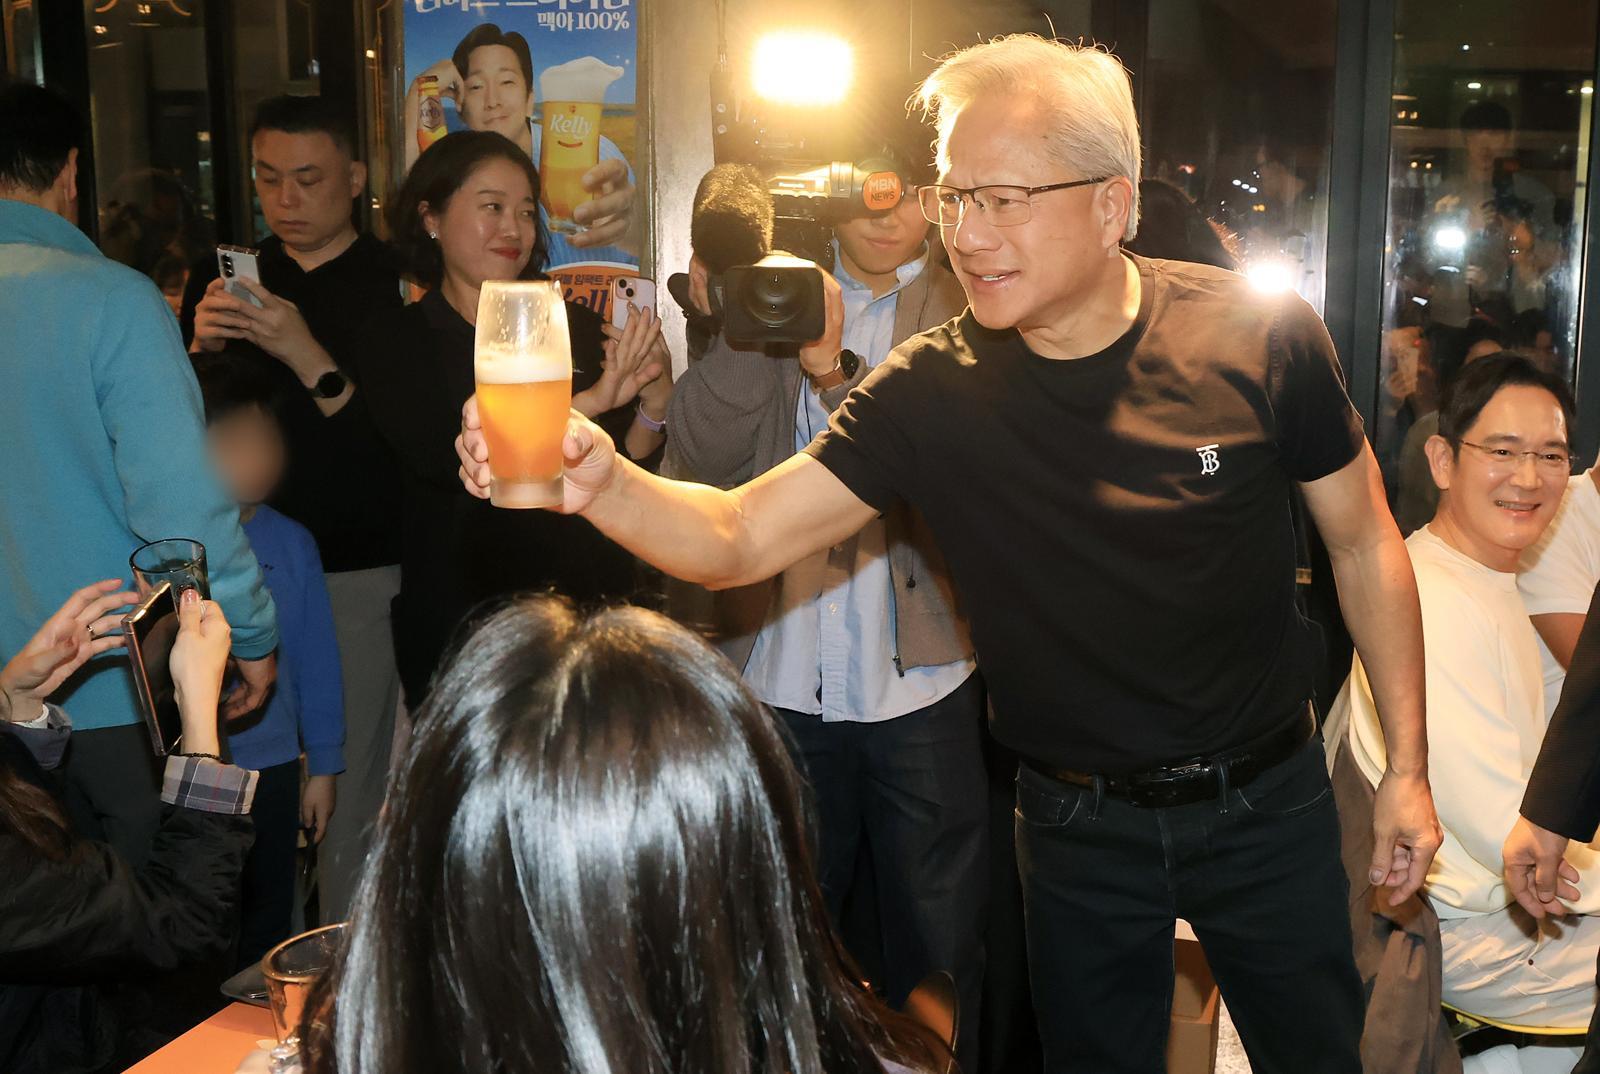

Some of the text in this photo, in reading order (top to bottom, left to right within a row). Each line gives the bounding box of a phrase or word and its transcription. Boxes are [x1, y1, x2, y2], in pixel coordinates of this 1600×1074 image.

[576, 11, 630, 31] 100%
[550, 114, 592, 139] Kelly
[868, 178, 897, 191] MBN
[870, 191, 895, 202] NEWS
